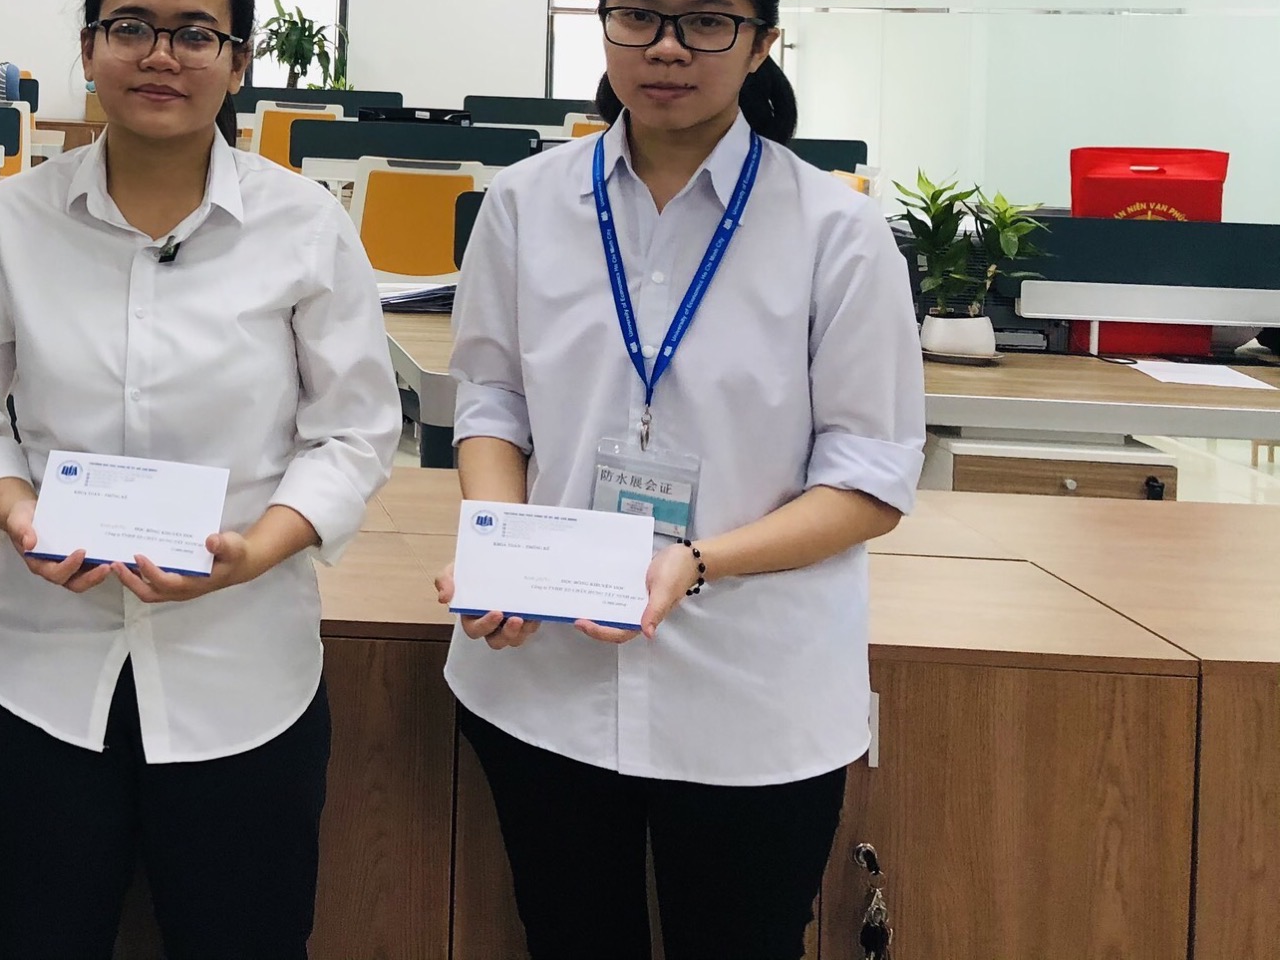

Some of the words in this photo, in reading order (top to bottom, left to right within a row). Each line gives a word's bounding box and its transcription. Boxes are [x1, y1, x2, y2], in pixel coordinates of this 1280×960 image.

[1126, 202, 1147, 214] NIÊN
[671, 316, 687, 341] University
[715, 237, 726, 248] City
[624, 310, 633, 337] University
[600, 469, 672, 495] 防水展会证
